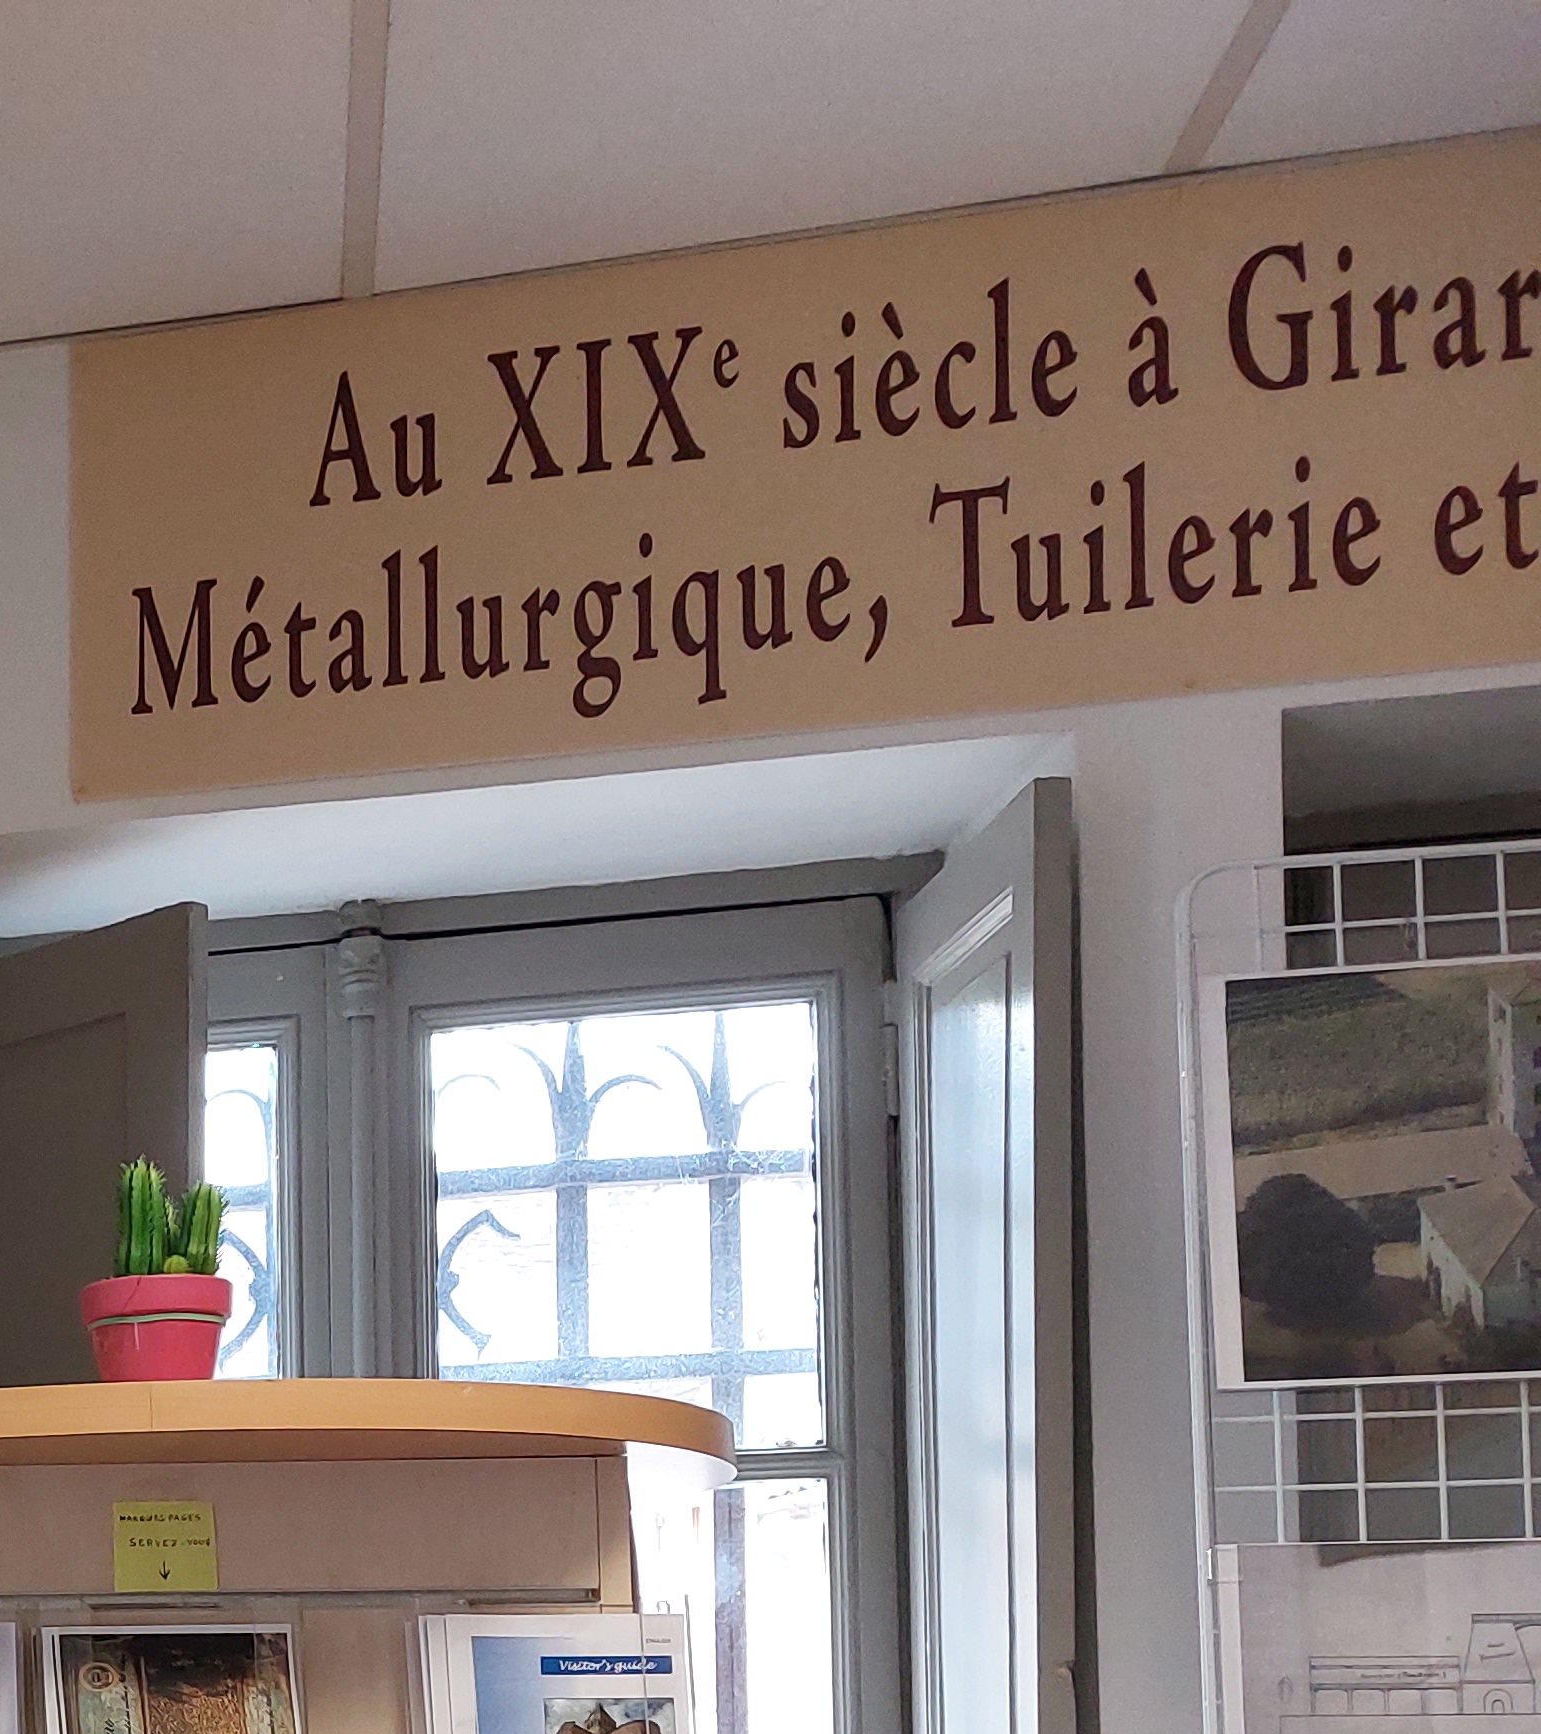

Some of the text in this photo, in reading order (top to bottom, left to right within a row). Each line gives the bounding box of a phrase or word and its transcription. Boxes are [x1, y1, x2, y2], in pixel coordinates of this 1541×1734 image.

[310, 241, 1541, 506] Au XIXe siècle à Girar
[131, 456, 1539, 717] Métallurgique, Tuilerie et
[559, 1657, 658, 1673] Visitor's guide
